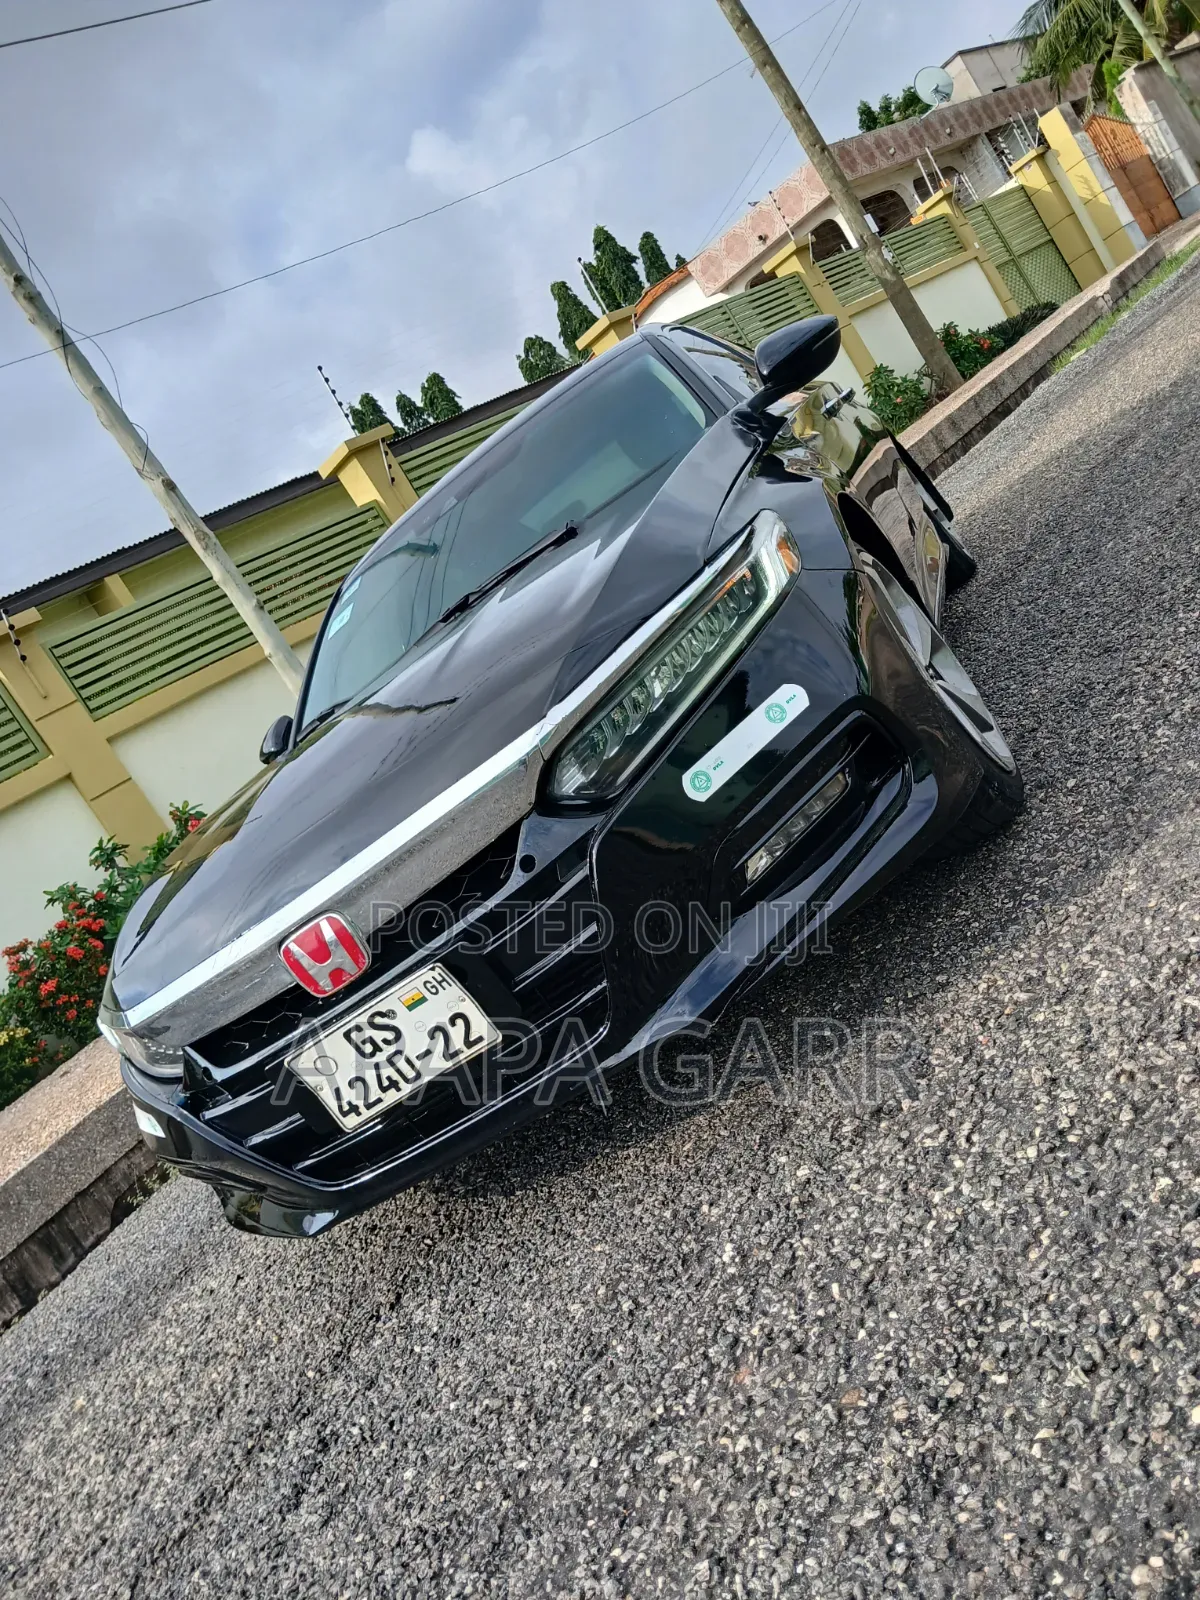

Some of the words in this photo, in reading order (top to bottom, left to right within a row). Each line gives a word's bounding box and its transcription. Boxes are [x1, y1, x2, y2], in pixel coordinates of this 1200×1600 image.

[423, 972, 452, 996] GH
[342, 1010, 402, 1060] GS
[334, 1012, 485, 1119] 4240-22
